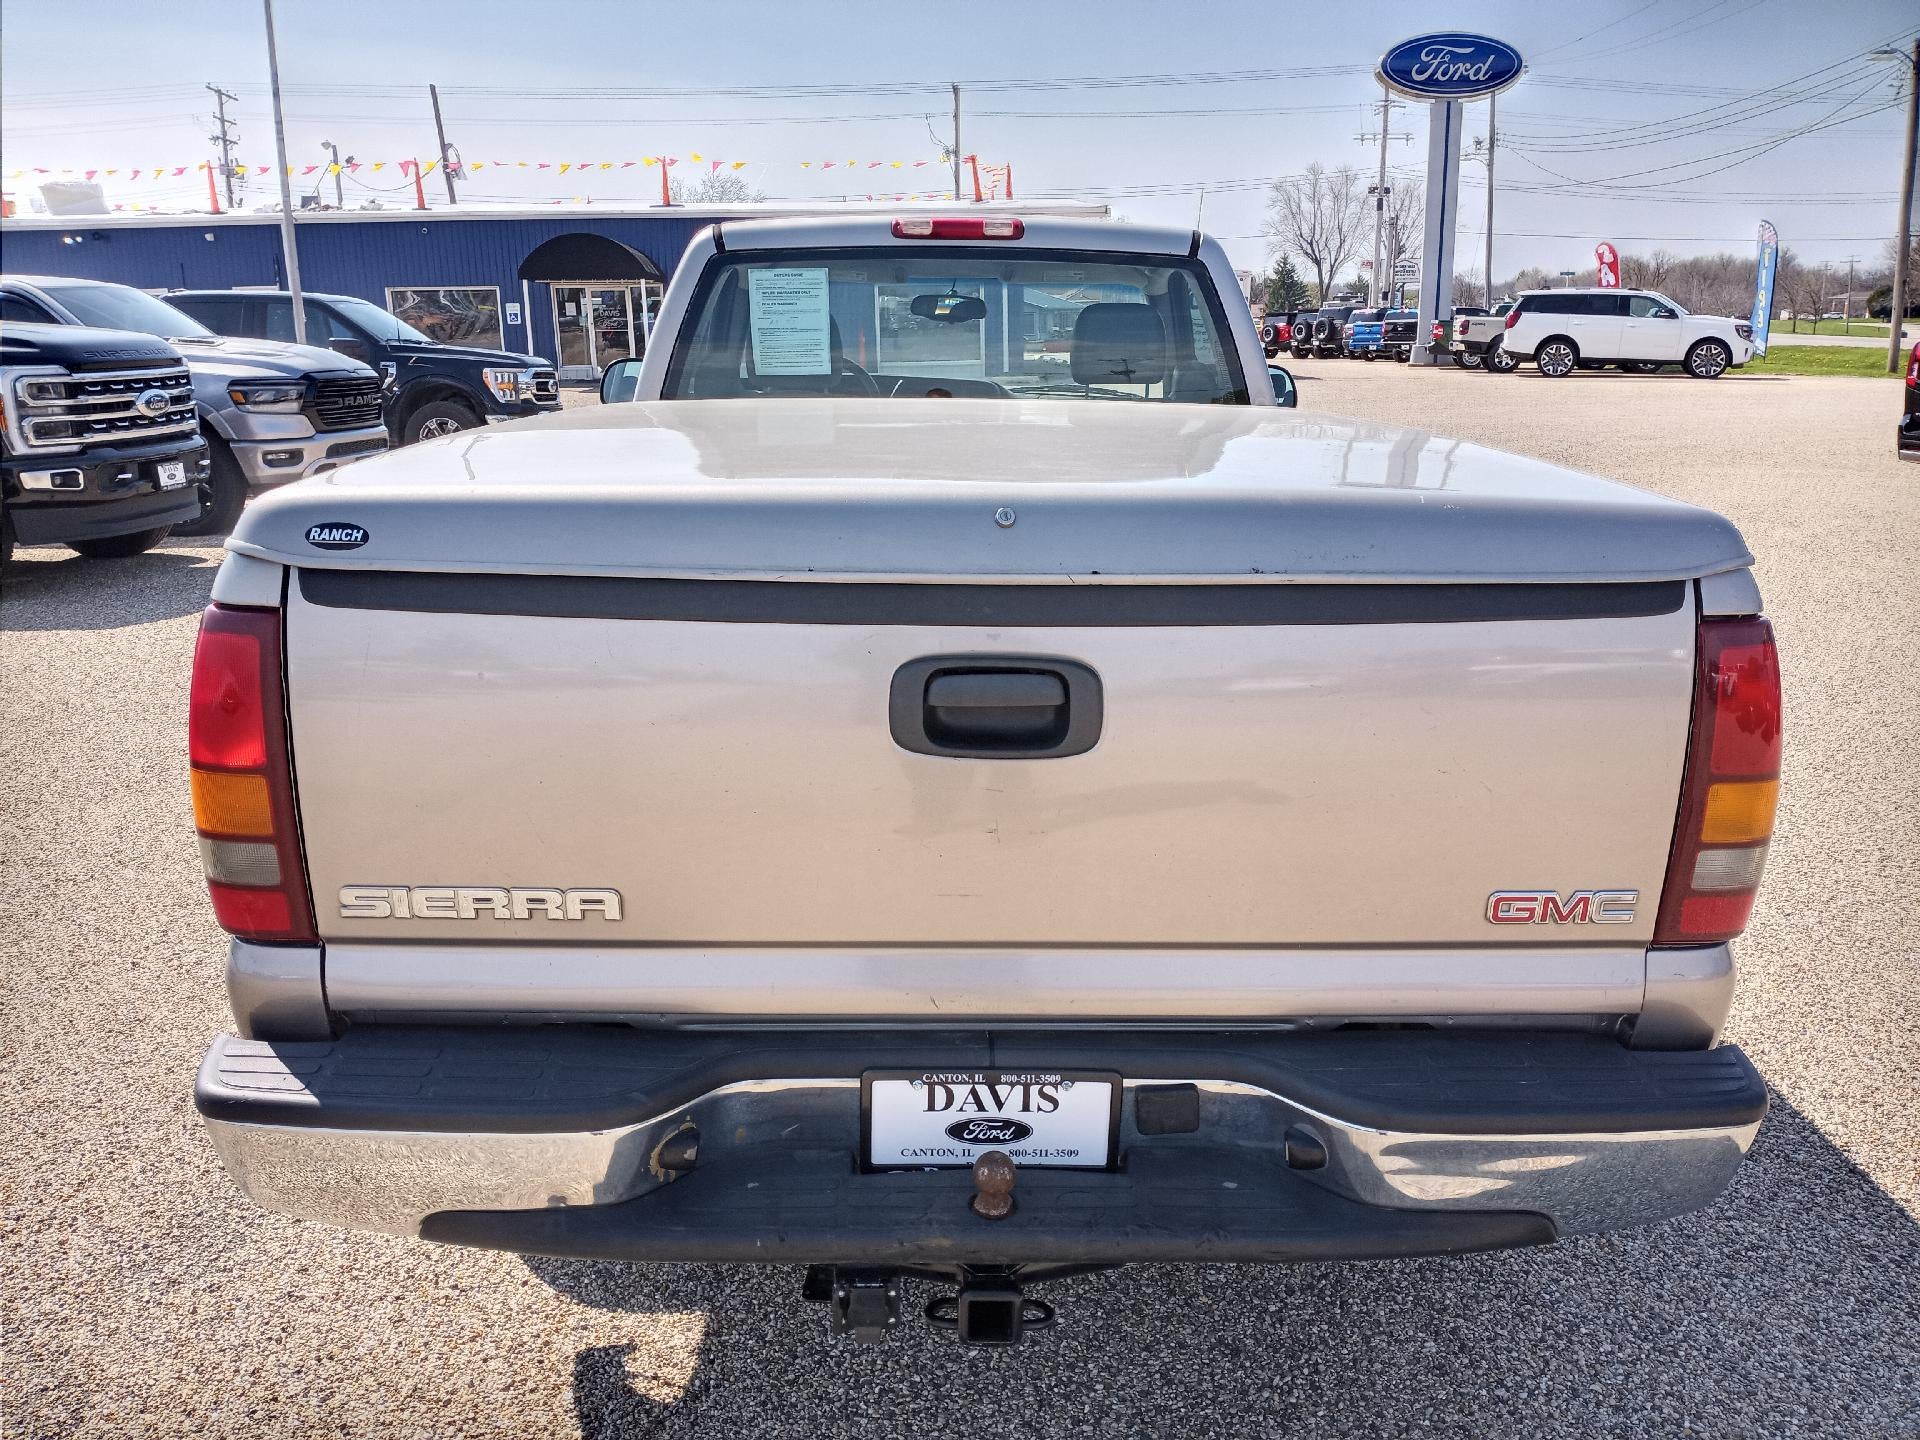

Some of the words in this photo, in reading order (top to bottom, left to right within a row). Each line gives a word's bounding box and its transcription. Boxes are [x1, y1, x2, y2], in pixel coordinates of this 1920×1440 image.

[1411, 45, 1495, 81] Ford
[150, 397, 166, 408] Ford
[344, 394, 373, 406] RAM
[309, 528, 363, 541] RANCH
[339, 885, 623, 920] SIERRA
[1486, 890, 1639, 924] GMC
[922, 1073, 972, 1083] CANTON,
[975, 1073, 986, 1083] IL
[1001, 1074, 1061, 1084] 800-511-3509
[923, 1084, 1060, 1113] DAVIS
[963, 1121, 1015, 1140] Ford
[901, 1148, 959, 1159] CANTON,
[962, 1148, 975, 1158] IL
[1008, 1148, 1079, 1158] 800-511-3509
